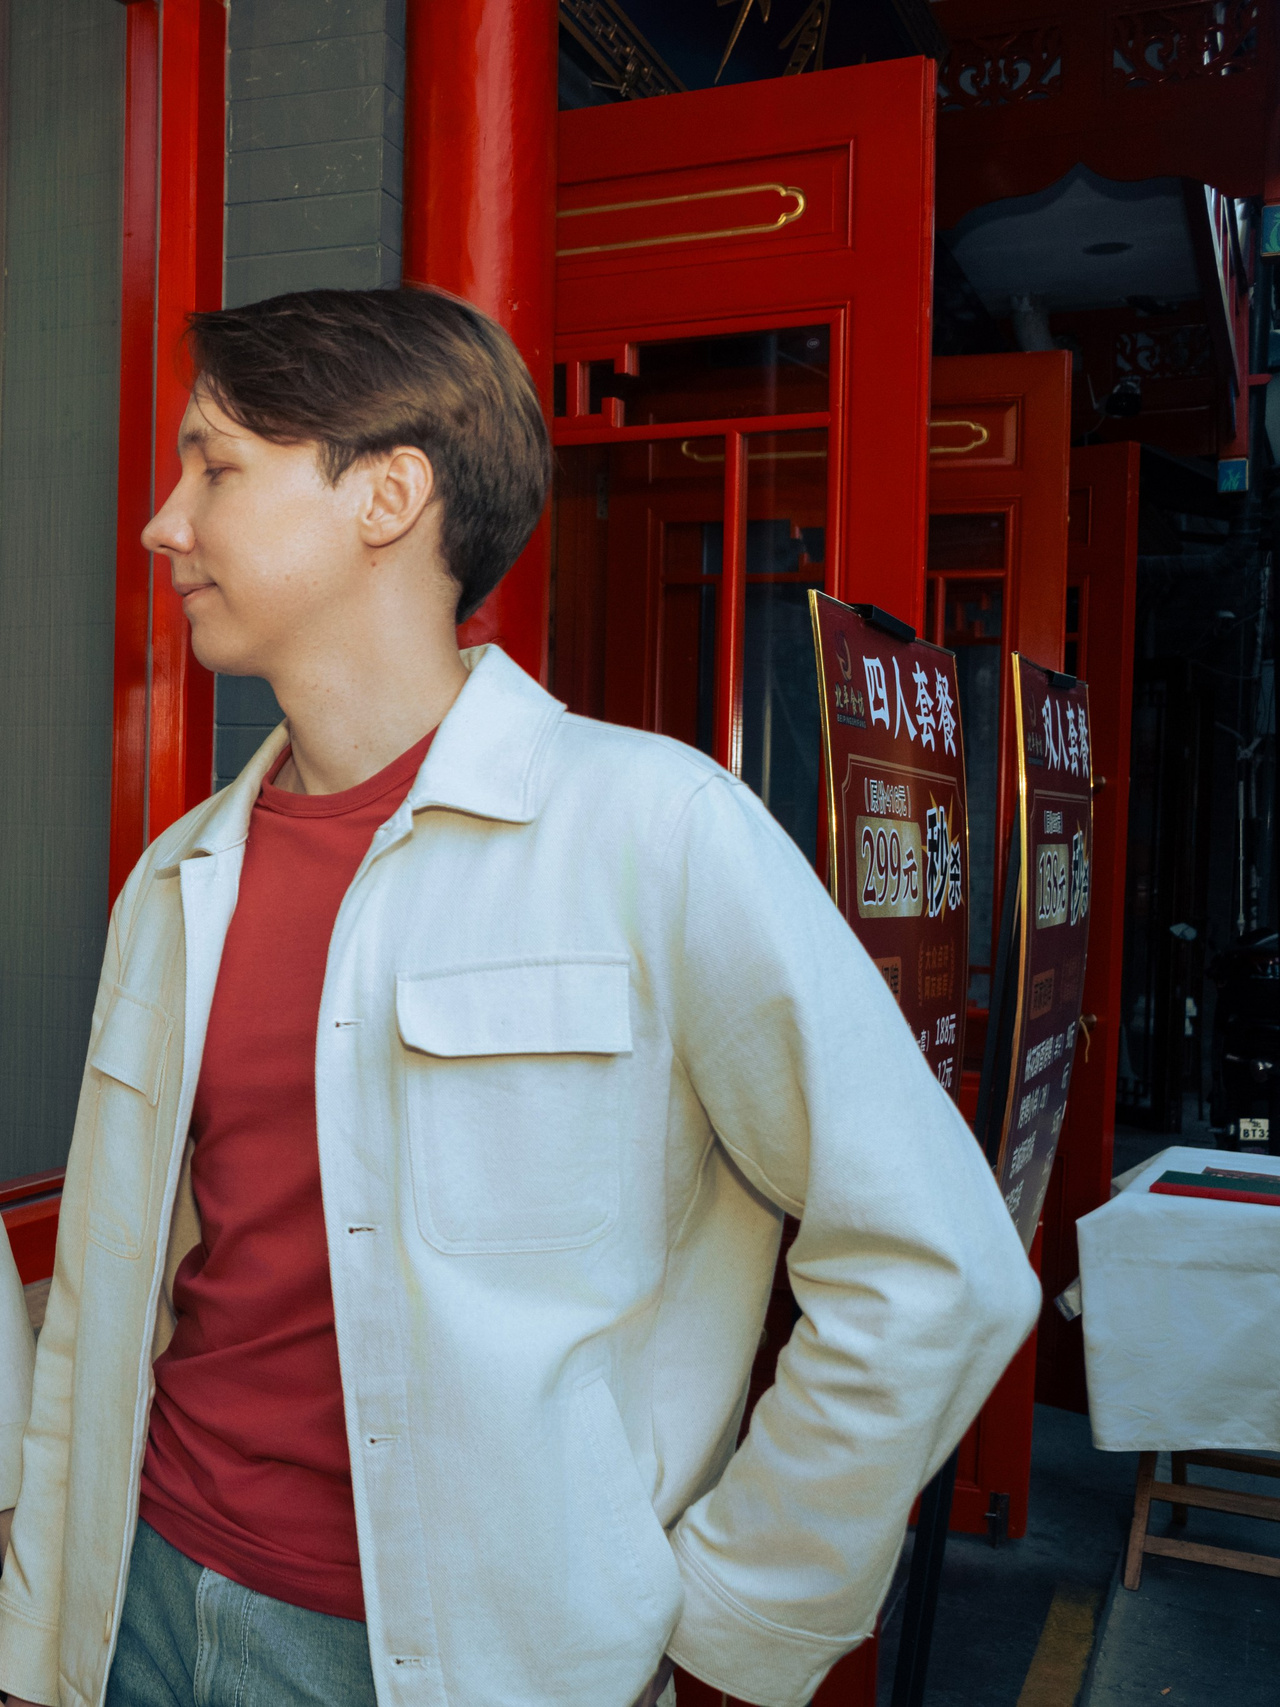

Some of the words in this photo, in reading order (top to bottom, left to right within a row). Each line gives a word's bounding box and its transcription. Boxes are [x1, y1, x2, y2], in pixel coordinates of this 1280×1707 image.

[862, 655, 957, 758] 四人套餐
[1041, 694, 1089, 779] 双人套餐
[861, 825, 919, 906] 299元
[925, 805, 962, 918] 秒杀
[935, 1013, 957, 1046] 188元
[937, 1057, 954, 1089] 12元
